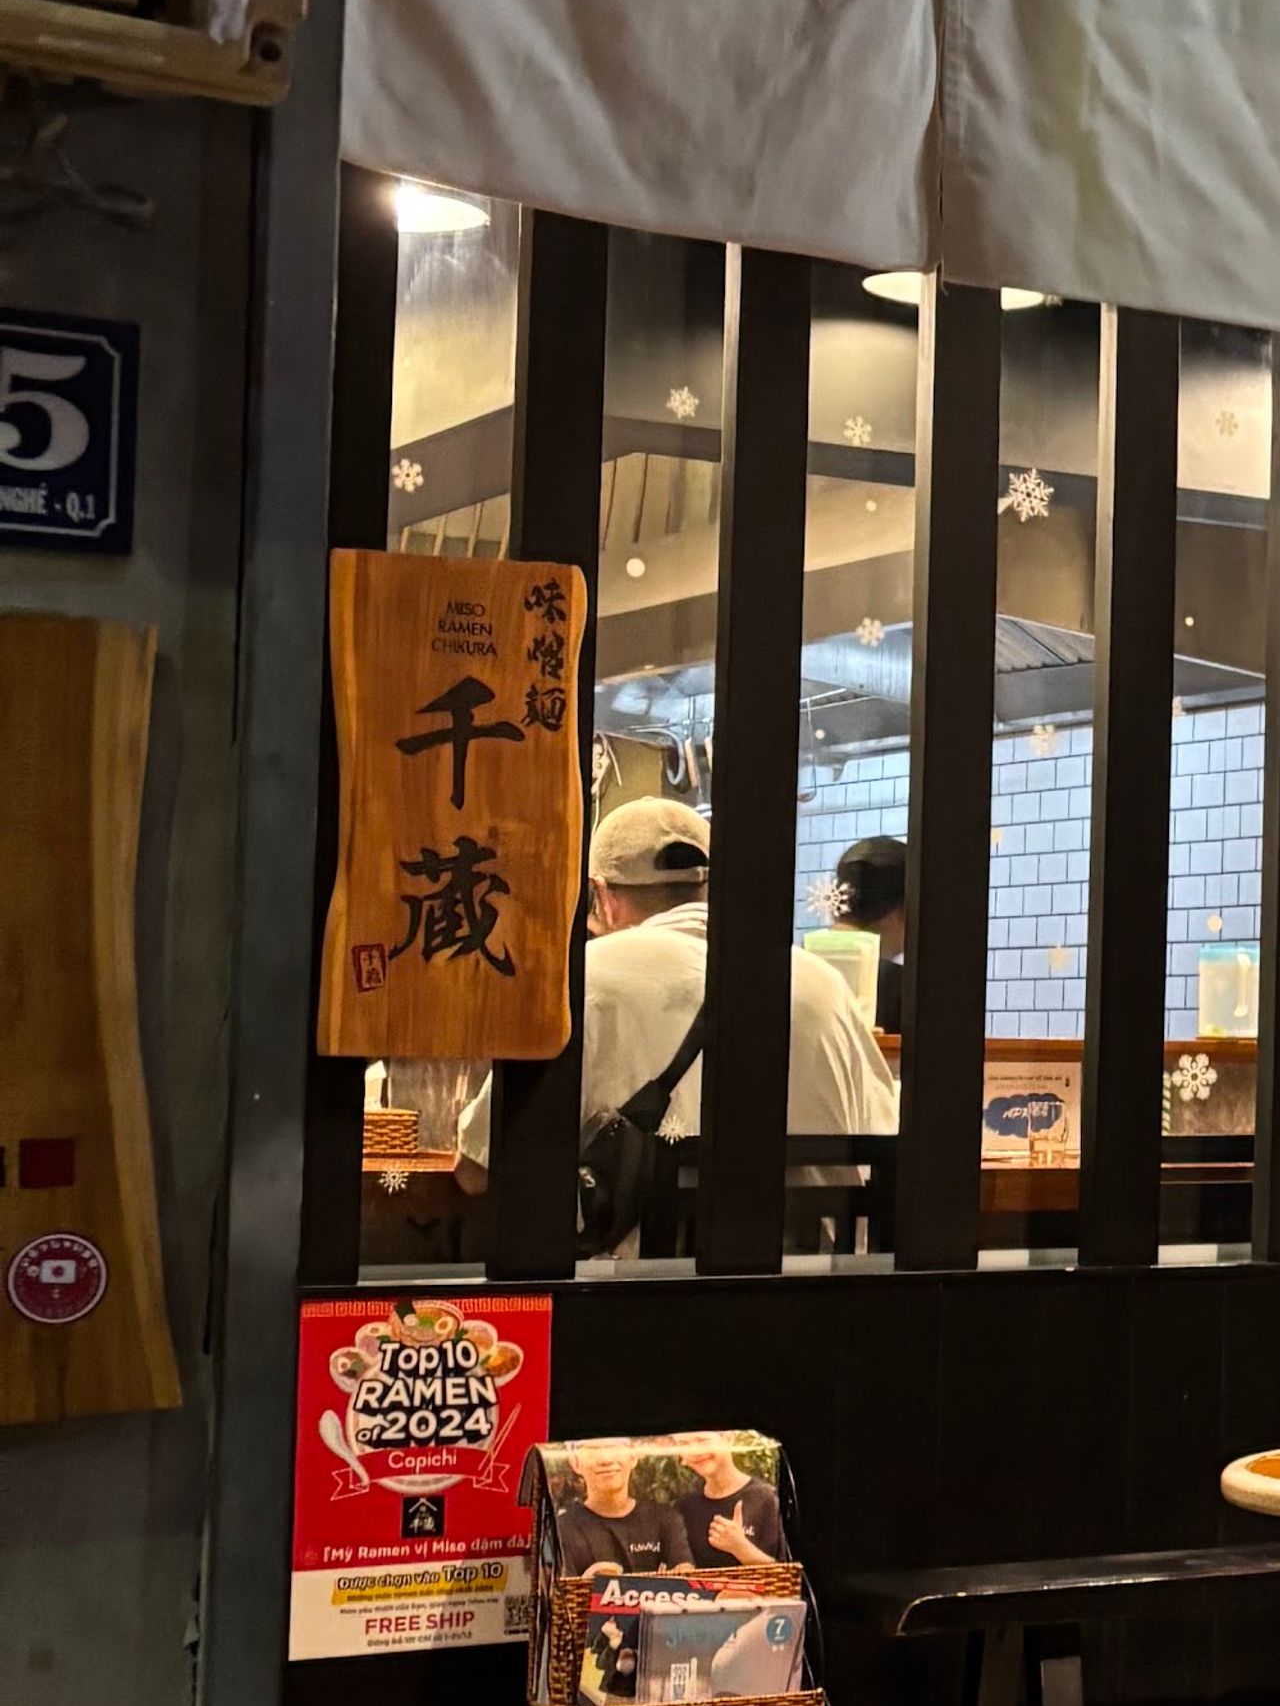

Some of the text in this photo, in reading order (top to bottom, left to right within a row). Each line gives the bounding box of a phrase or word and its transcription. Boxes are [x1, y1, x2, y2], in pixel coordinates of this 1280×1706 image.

[445, 600, 486, 618] MISO
[438, 620, 493, 638] RAMEN
[431, 638, 498, 659] CHIKURA
[389, 676, 525, 977] 千蔵
[381, 1340, 478, 1376] Top 10
[355, 1376, 497, 1409] RAMEN
[357, 1408, 491, 1441] of 2024
[388, 1449, 457, 1474] Capichi
[442, 1565, 477, 1583] Top
[481, 1562, 504, 1580] 10
[600, 1579, 700, 1608] Access
[365, 1611, 476, 1635] FREE SHIP
